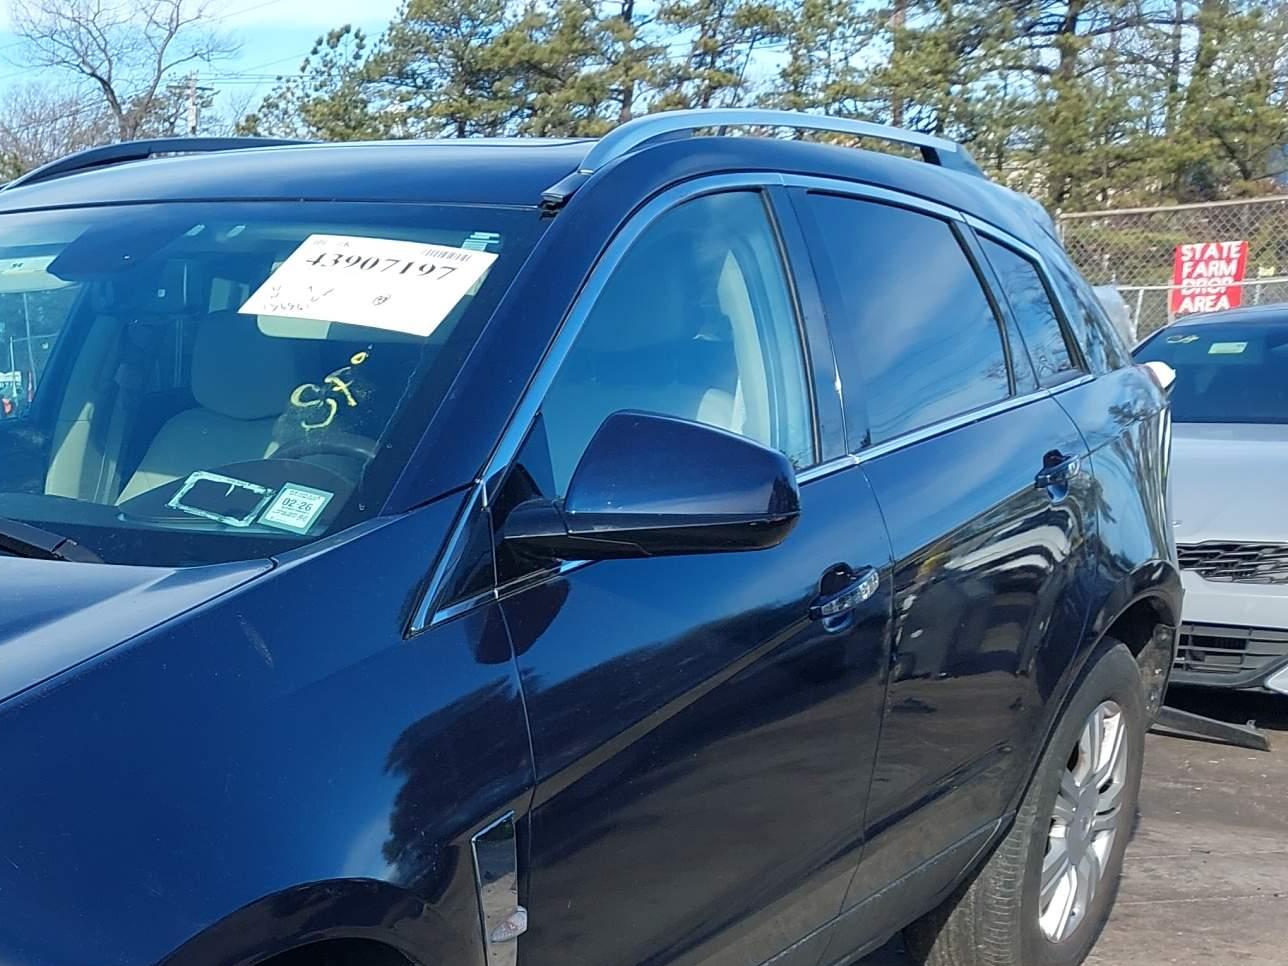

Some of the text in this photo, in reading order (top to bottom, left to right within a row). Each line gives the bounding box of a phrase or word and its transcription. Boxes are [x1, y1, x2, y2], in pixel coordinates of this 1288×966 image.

[1181, 241, 1241, 262] STATE
[305, 252, 458, 281] 43907197
[1182, 259, 1238, 279] FARM
[1181, 276, 1234, 296] DROP
[1178, 294, 1230, 313] AREA
